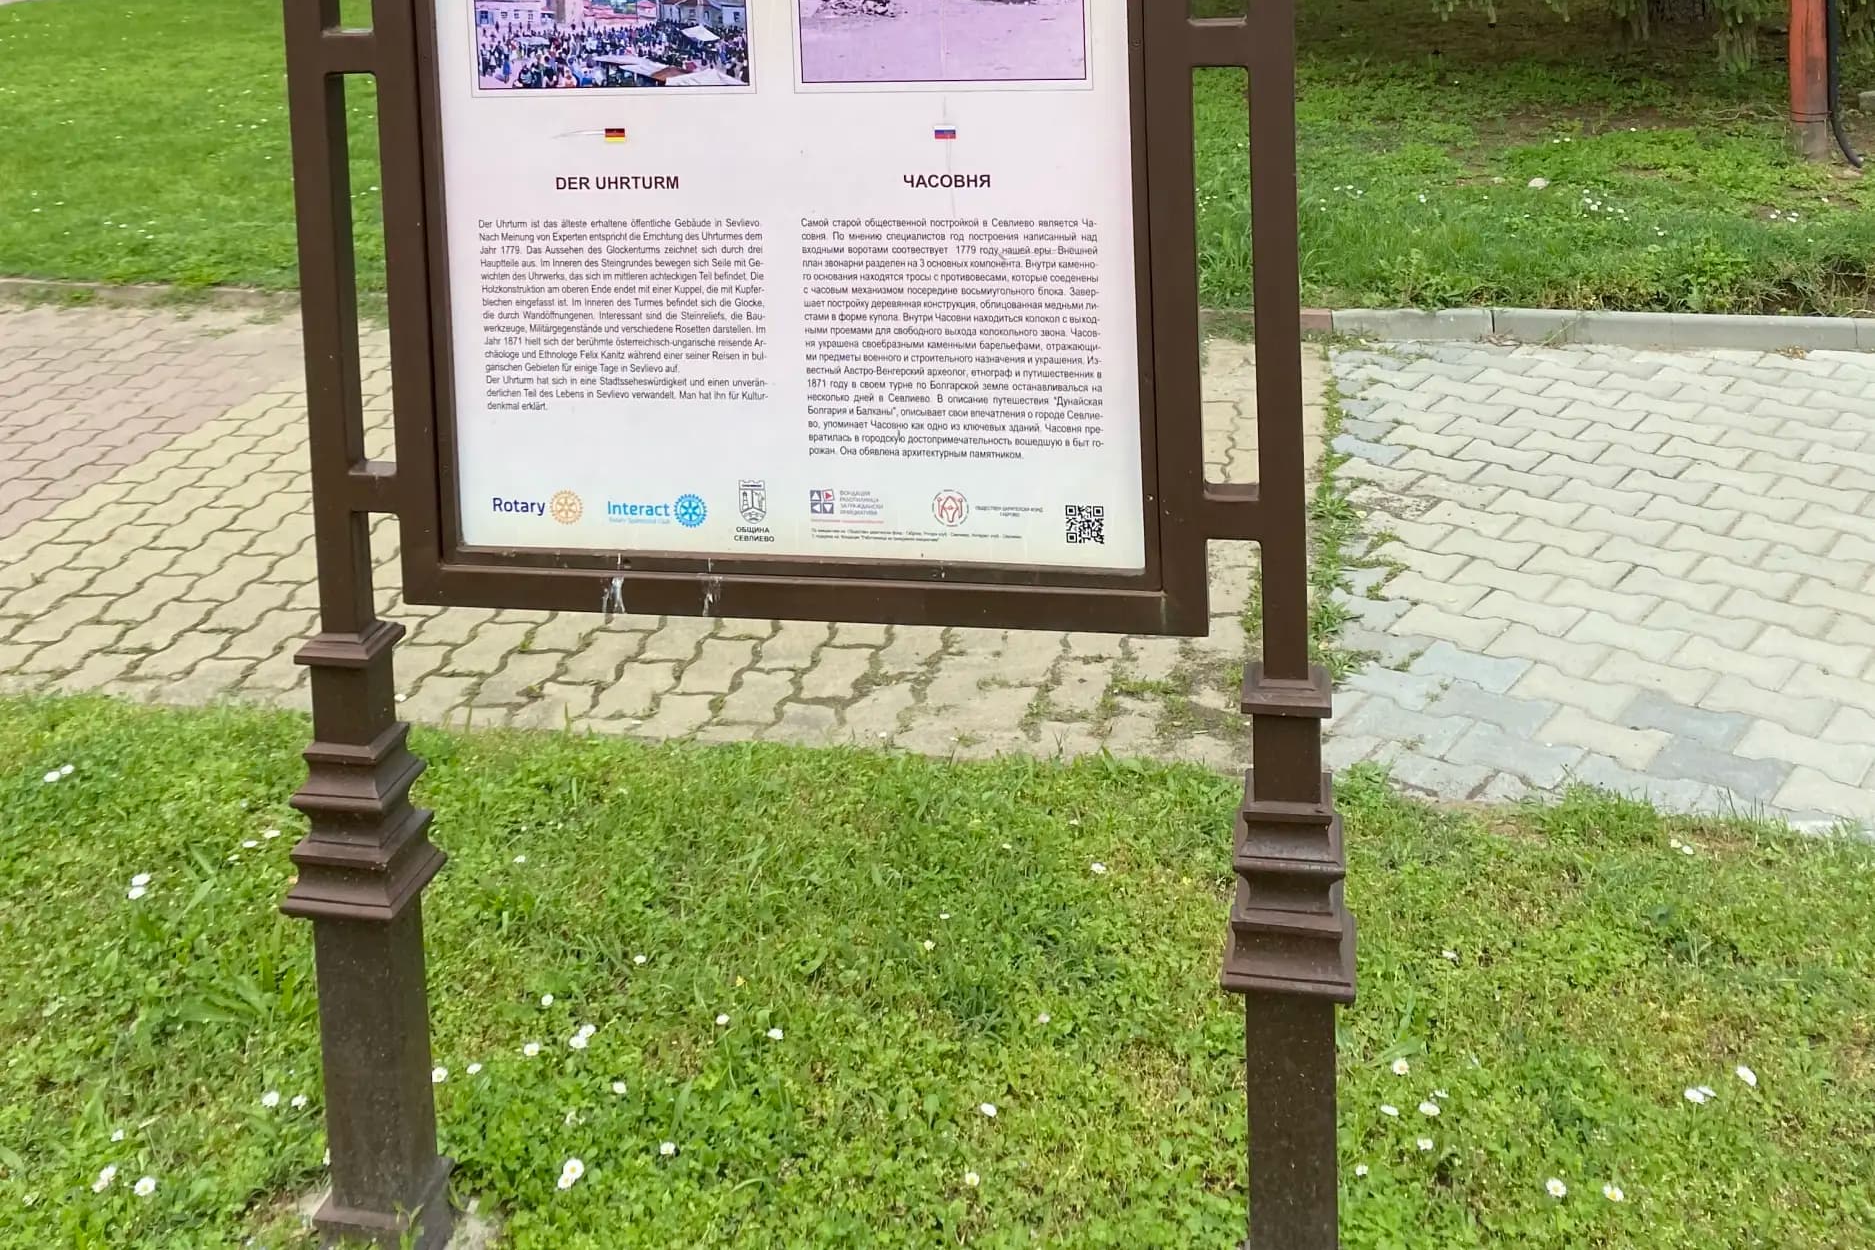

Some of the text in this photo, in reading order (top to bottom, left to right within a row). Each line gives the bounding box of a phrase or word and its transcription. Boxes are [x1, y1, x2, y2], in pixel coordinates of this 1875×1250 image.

[556, 176, 679, 190] DER UHRTURM
[903, 174, 991, 188] ЧАСОВНЯ
[478, 219, 493, 228] Der
[496, 219, 527, 228] Uhrturm
[530, 220, 540, 228] ist
[543, 220, 558, 228] das
[561, 219, 588, 227] älteste
[590, 219, 627, 227] erhaltene
[674, 218, 711, 227] Gebäude
[715, 218, 722, 227] in
[801, 217, 829, 227] Самой
[832, 218, 862, 227] старой
[865, 217, 927, 227] общественной
[930, 218, 979, 228] постройкой
[991, 218, 1035, 227] Севлиево
[1082, 218, 1097, 227] Ча-
[479, 233, 500, 241] Nach
[501, 232, 535, 242] Meinung
[552, 232, 588, 242] Experten
[589, 232, 627, 241] entspricht
[629, 232, 641, 240] die
[684, 232, 700, 240] des
[701, 231, 743, 240] Uhrturmes
[744, 231, 763, 240] dem
[832, 231, 845, 240] По
[886, 233, 946, 242] специалистов
[950, 233, 964, 241] год
[968, 233, 1019, 242] построения
[1023, 232, 1077, 240] написанный
[1081, 234, 1098, 242] над
[480, 246, 497, 254] Jahr
[526, 245, 542, 254] Das
[544, 245, 584, 254] Aussehen
[587, 245, 602, 254] des
[606, 245, 661, 254] Glockenturms
[664, 245, 698, 253] zeichnet
[701, 245, 717, 253] sich
[721, 245, 744, 253] durch
[747, 245, 763, 253] drei
[811, 286, 848, 294] часовым
[907, 287, 958, 296] посередине
[961, 288, 1035, 297] восьмиугольного
[1069, 286, 1100, 297] Завер-
[482, 310, 495, 319] die
[497, 310, 520, 319] durch
[599, 311, 643, 320] Interessant
[646, 311, 662, 319] sind
[665, 311, 678, 319] die
[730, 311, 743, 320] die
[746, 311, 766, 320] Bau-
[483, 323, 766, 335] werkzeuge, Militärgegenstände und verschiedene Rosetten darstellen. Im
[830, 327, 873, 335] проемами
[874, 327, 891, 335] для
[893, 325, 942, 336] свободного
[944, 328, 977, 336] выхода
[979, 328, 1038, 336] колокольного
[1070, 327, 1101, 337] Часов-
[484, 336, 501, 345] Jahr
[504, 336, 522, 345] 1871
[543, 337, 559, 345] sich
[561, 337, 575, 345] der
[576, 337, 613, 346] berühmte
[718, 338, 752, 347] reisende
[754, 338, 767, 346] Ar-
[818, 340, 859, 350] украшена
[927, 341, 976, 349] каменными
[979, 340, 1043, 351] барельефами,
[524, 362, 560, 371] Gebieten
[562, 363, 572, 371] für
[574, 363, 598, 374] einige
[599, 363, 619, 374] Tage
[620, 364, 628, 372] in
[629, 363, 663, 372] Sevlievo
[806, 365, 841, 374] вестный
[843, 365, 925, 377] Австро-Венгерский
[927, 368, 969, 378] археолог,
[486, 375, 500, 384] Der
[503, 375, 534, 384] Uhrturm
[536, 376, 549, 384] hat
[552, 376, 567, 384] sich
[570, 376, 578, 384] in
[580, 376, 597, 385] eine
[690, 377, 705, 386] und
[732, 379, 768, 387] unverän-
[487, 401, 548, 410] denkmal erklärt.
[853, 393, 874, 402] дней
[993, 396, 1049, 406] путешествия
[808, 433, 852, 443] вратилась
[907, 436, 1012, 446] достопримечательность
[1015, 438, 1063, 448] вошедшую
[1073, 437, 1090, 447] быт
[840, 445, 857, 455] Она
[859, 446, 900, 456] обявлена
[902, 449, 967, 459] архитектурным
[492, 497, 546, 516] Rotary
[607, 500, 671, 517] Interact
[735, 526, 770, 534] ОБЩИНА
